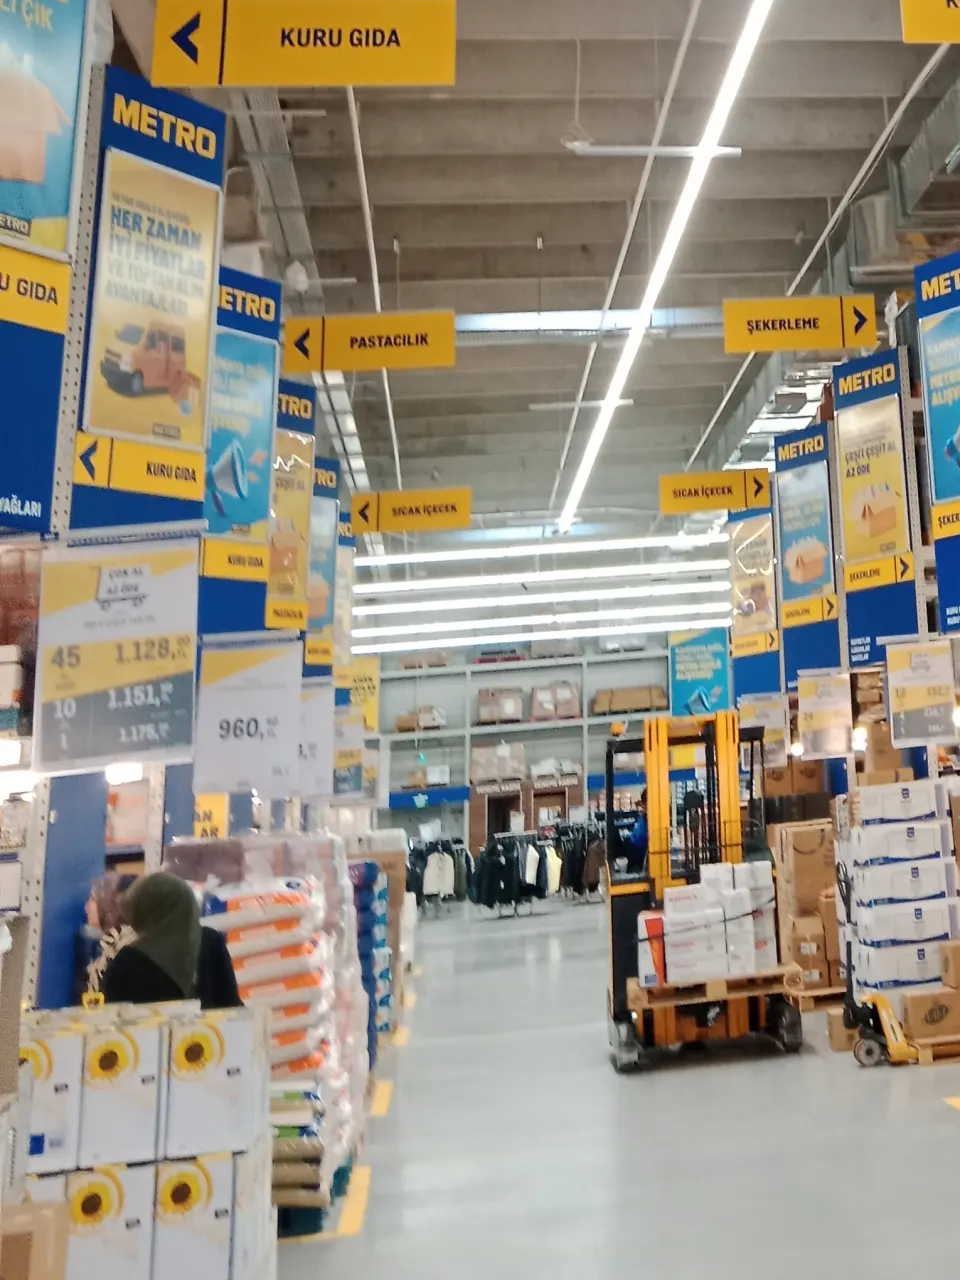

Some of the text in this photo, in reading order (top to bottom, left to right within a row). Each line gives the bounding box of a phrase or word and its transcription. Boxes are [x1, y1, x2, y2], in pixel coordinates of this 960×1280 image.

[280, 27, 401, 48] KURU GIDA
[112, 92, 216, 160] METRO
[111, 204, 143, 233] HER
[146, 216, 203, 250] ZAMAN
[17, 277, 58, 306] GIDA
[218, 284, 275, 322] ETRO
[746, 316, 820, 336] ŞEKERLEME
[349, 332, 429, 349] PASTACILIK
[839, 363, 895, 395] METRO
[778, 435, 824, 462] METRO
[146, 461, 197, 484] KURU GIDA
[672, 482, 734, 500] SICAK İÇECEK
[392, 499, 458, 518] SICAK İÇECEK
[52, 644, 81, 669] 45
[54, 698, 77, 719] 10
